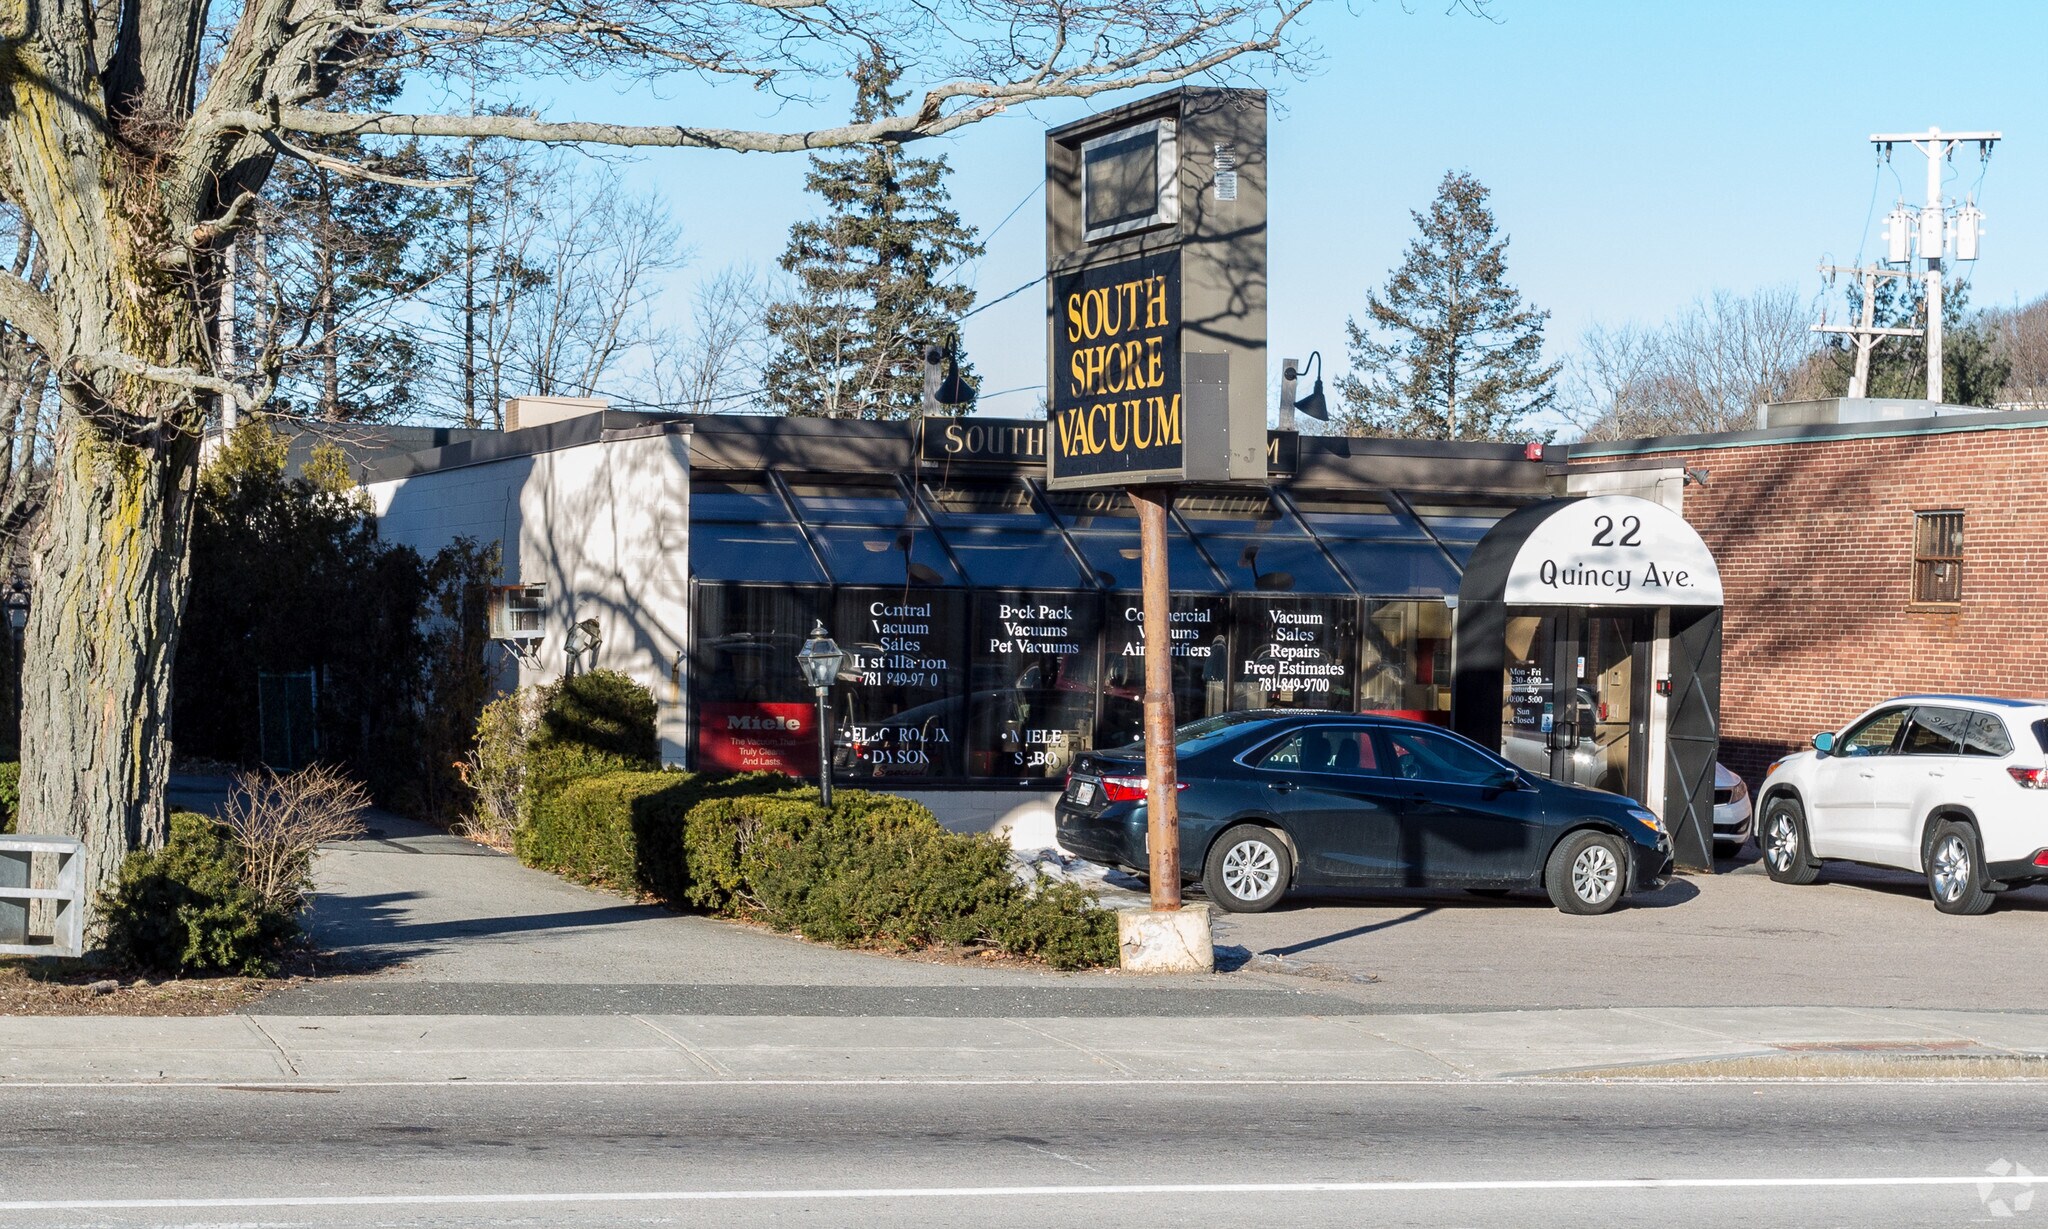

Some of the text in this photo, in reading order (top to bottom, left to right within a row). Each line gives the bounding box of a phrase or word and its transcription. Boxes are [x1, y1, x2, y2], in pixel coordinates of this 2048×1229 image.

[1068, 275, 1169, 343] SOUTH
[1071, 336, 1165, 399] SHORE
[1056, 393, 1182, 458] VACUUM
[945, 424, 1045, 456] SOUTH
[1591, 515, 1642, 547] 22
[1539, 559, 1694, 594] Quincy Ave.
[1039, 605, 1073, 620] Pack
[1125, 607, 1211, 623] Coercial
[1269, 609, 1323, 625] Vacuum
[1004, 622, 1068, 637] Vacuums
[1137, 625, 1199, 640] Vums
[1276, 627, 1314, 641] Sales
[880, 637, 921, 651] Sales
[990, 639, 1079, 654] Pet Vacuums
[1122, 642, 1211, 657] Air rifiers
[1270, 643, 1320, 661] Repairs
[1243, 660, 1345, 676] Free Estimates
[1531, 667, 1541, 676] Fri
[1258, 677, 1330, 692] 781-849-9700
[1516, 707, 1530, 715] Sun
[727, 715, 801, 731] Miele
[1511, 716, 1535, 724] Closed
[730, 737, 746, 746] The
[739, 747, 758, 757] Truly
[742, 757, 783, 766] And Lasts.
